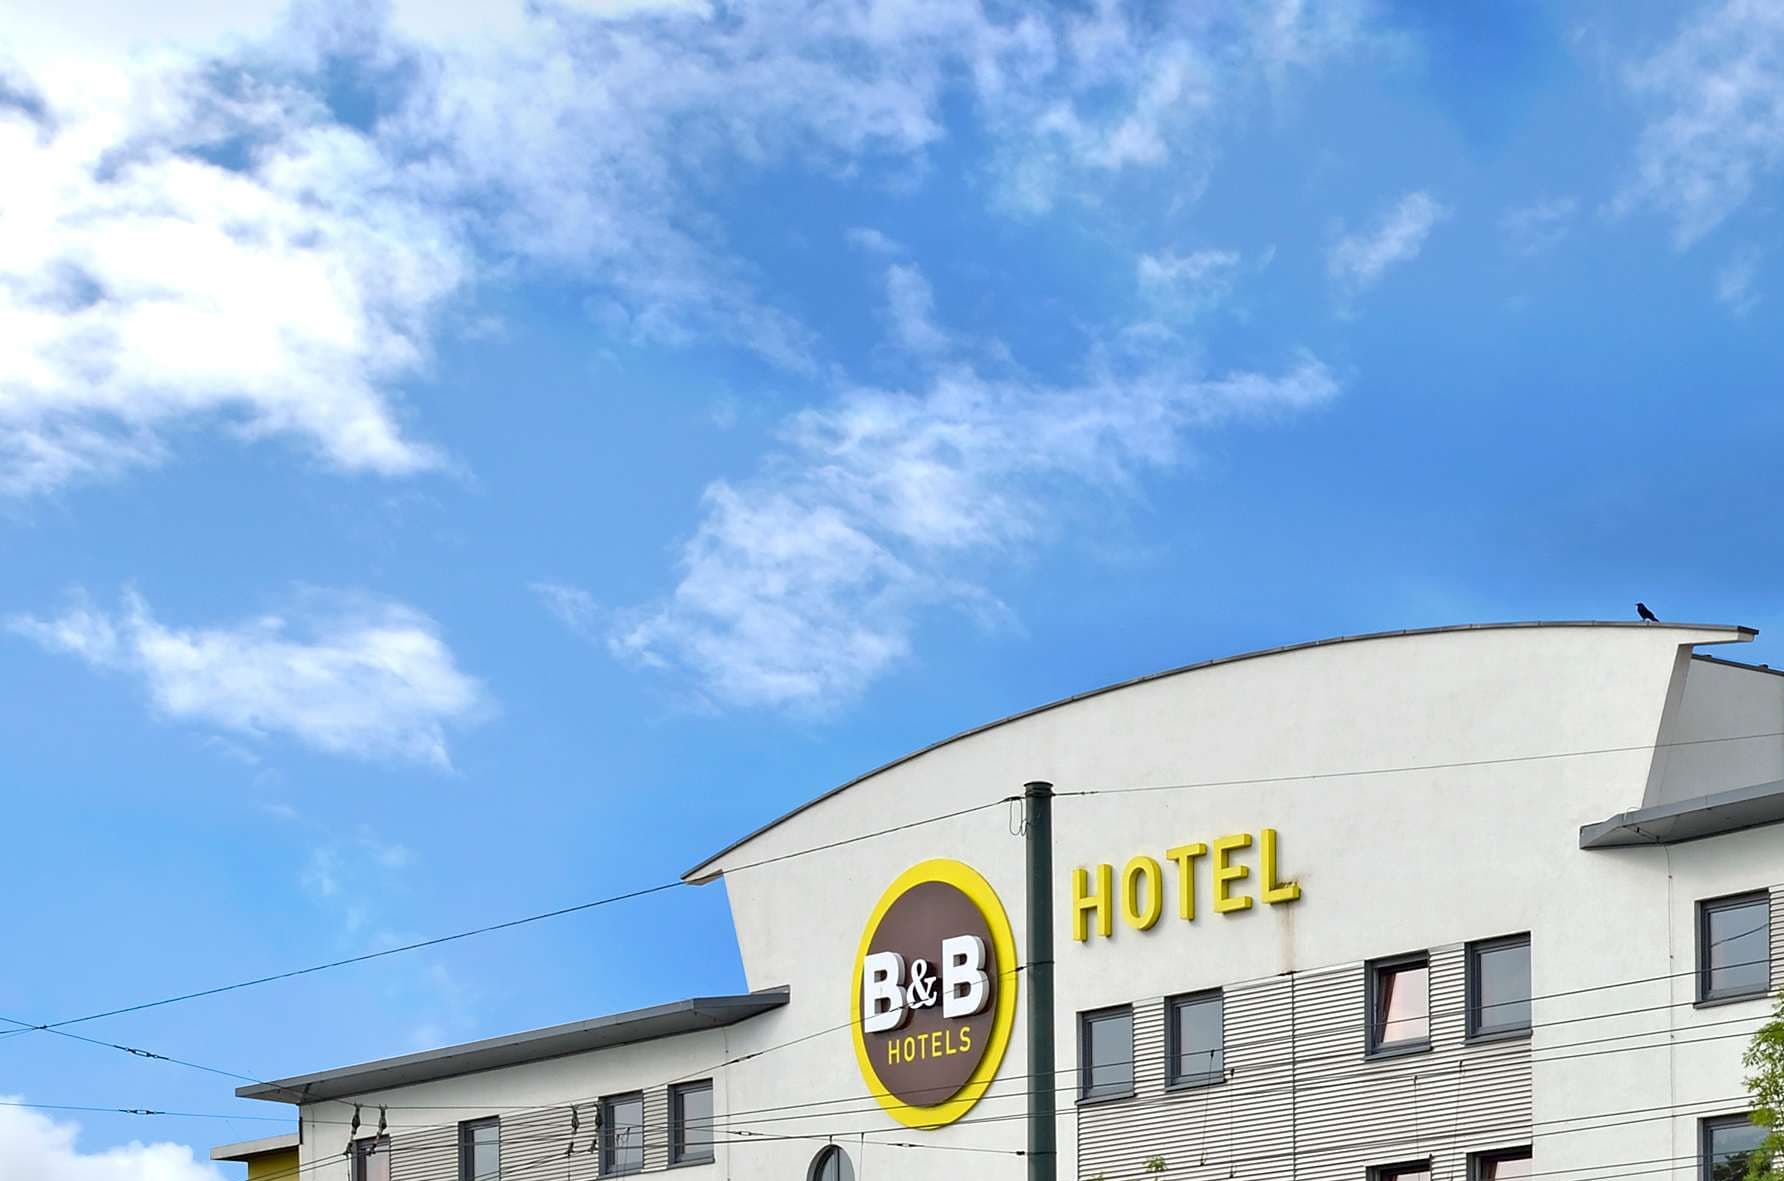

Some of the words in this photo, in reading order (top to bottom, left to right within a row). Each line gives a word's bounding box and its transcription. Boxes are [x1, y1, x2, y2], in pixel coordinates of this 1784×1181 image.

[1071, 828, 1301, 942] HOTEL
[863, 934, 990, 1033] B&B
[887, 1025, 972, 1065] HOTELS
